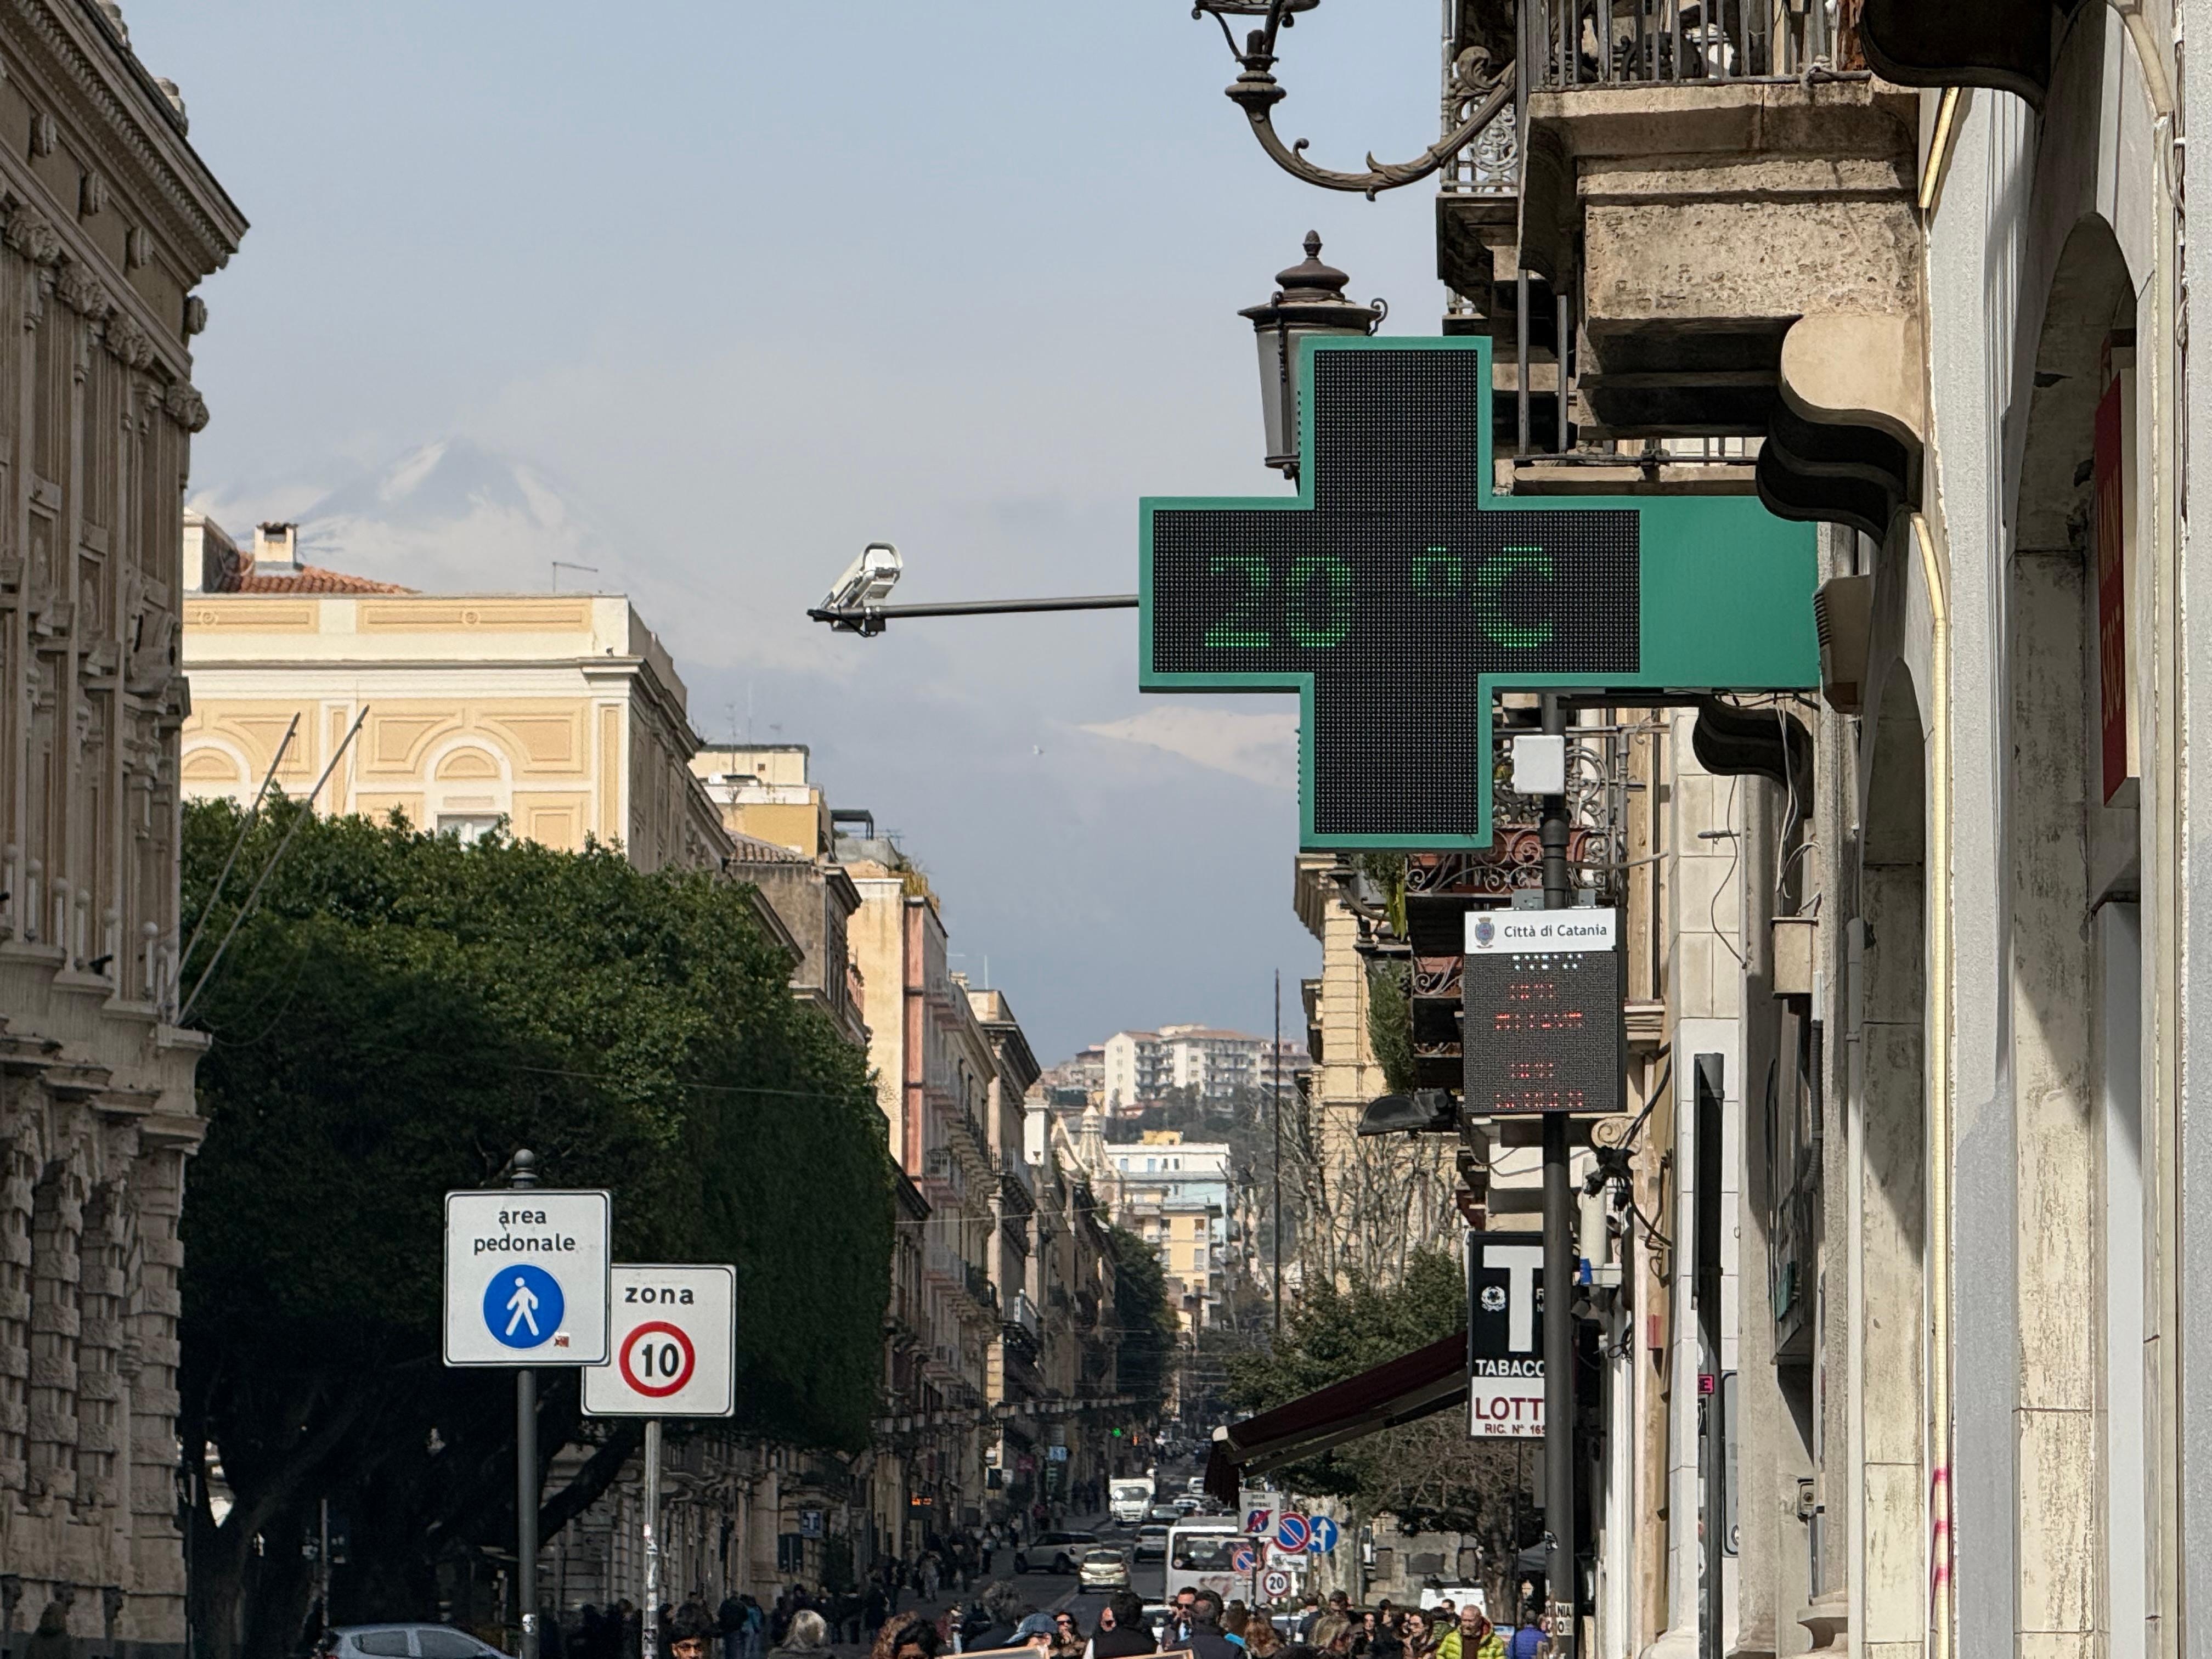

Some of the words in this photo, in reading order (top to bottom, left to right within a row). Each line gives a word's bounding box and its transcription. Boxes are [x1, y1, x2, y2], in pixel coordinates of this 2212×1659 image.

[1205, 556, 1351, 648] 20
[1504, 924, 1536, 938] Città
[1541, 924, 1553, 937] di
[1557, 923, 1607, 936] Catania
[498, 1209, 547, 1224] area
[473, 1233, 576, 1256] pedonale
[625, 1286, 695, 1305] zona
[1483, 1245, 1544, 1352] T
[642, 1343, 680, 1378] 10
[1268, 1576, 1284, 1590] 20
